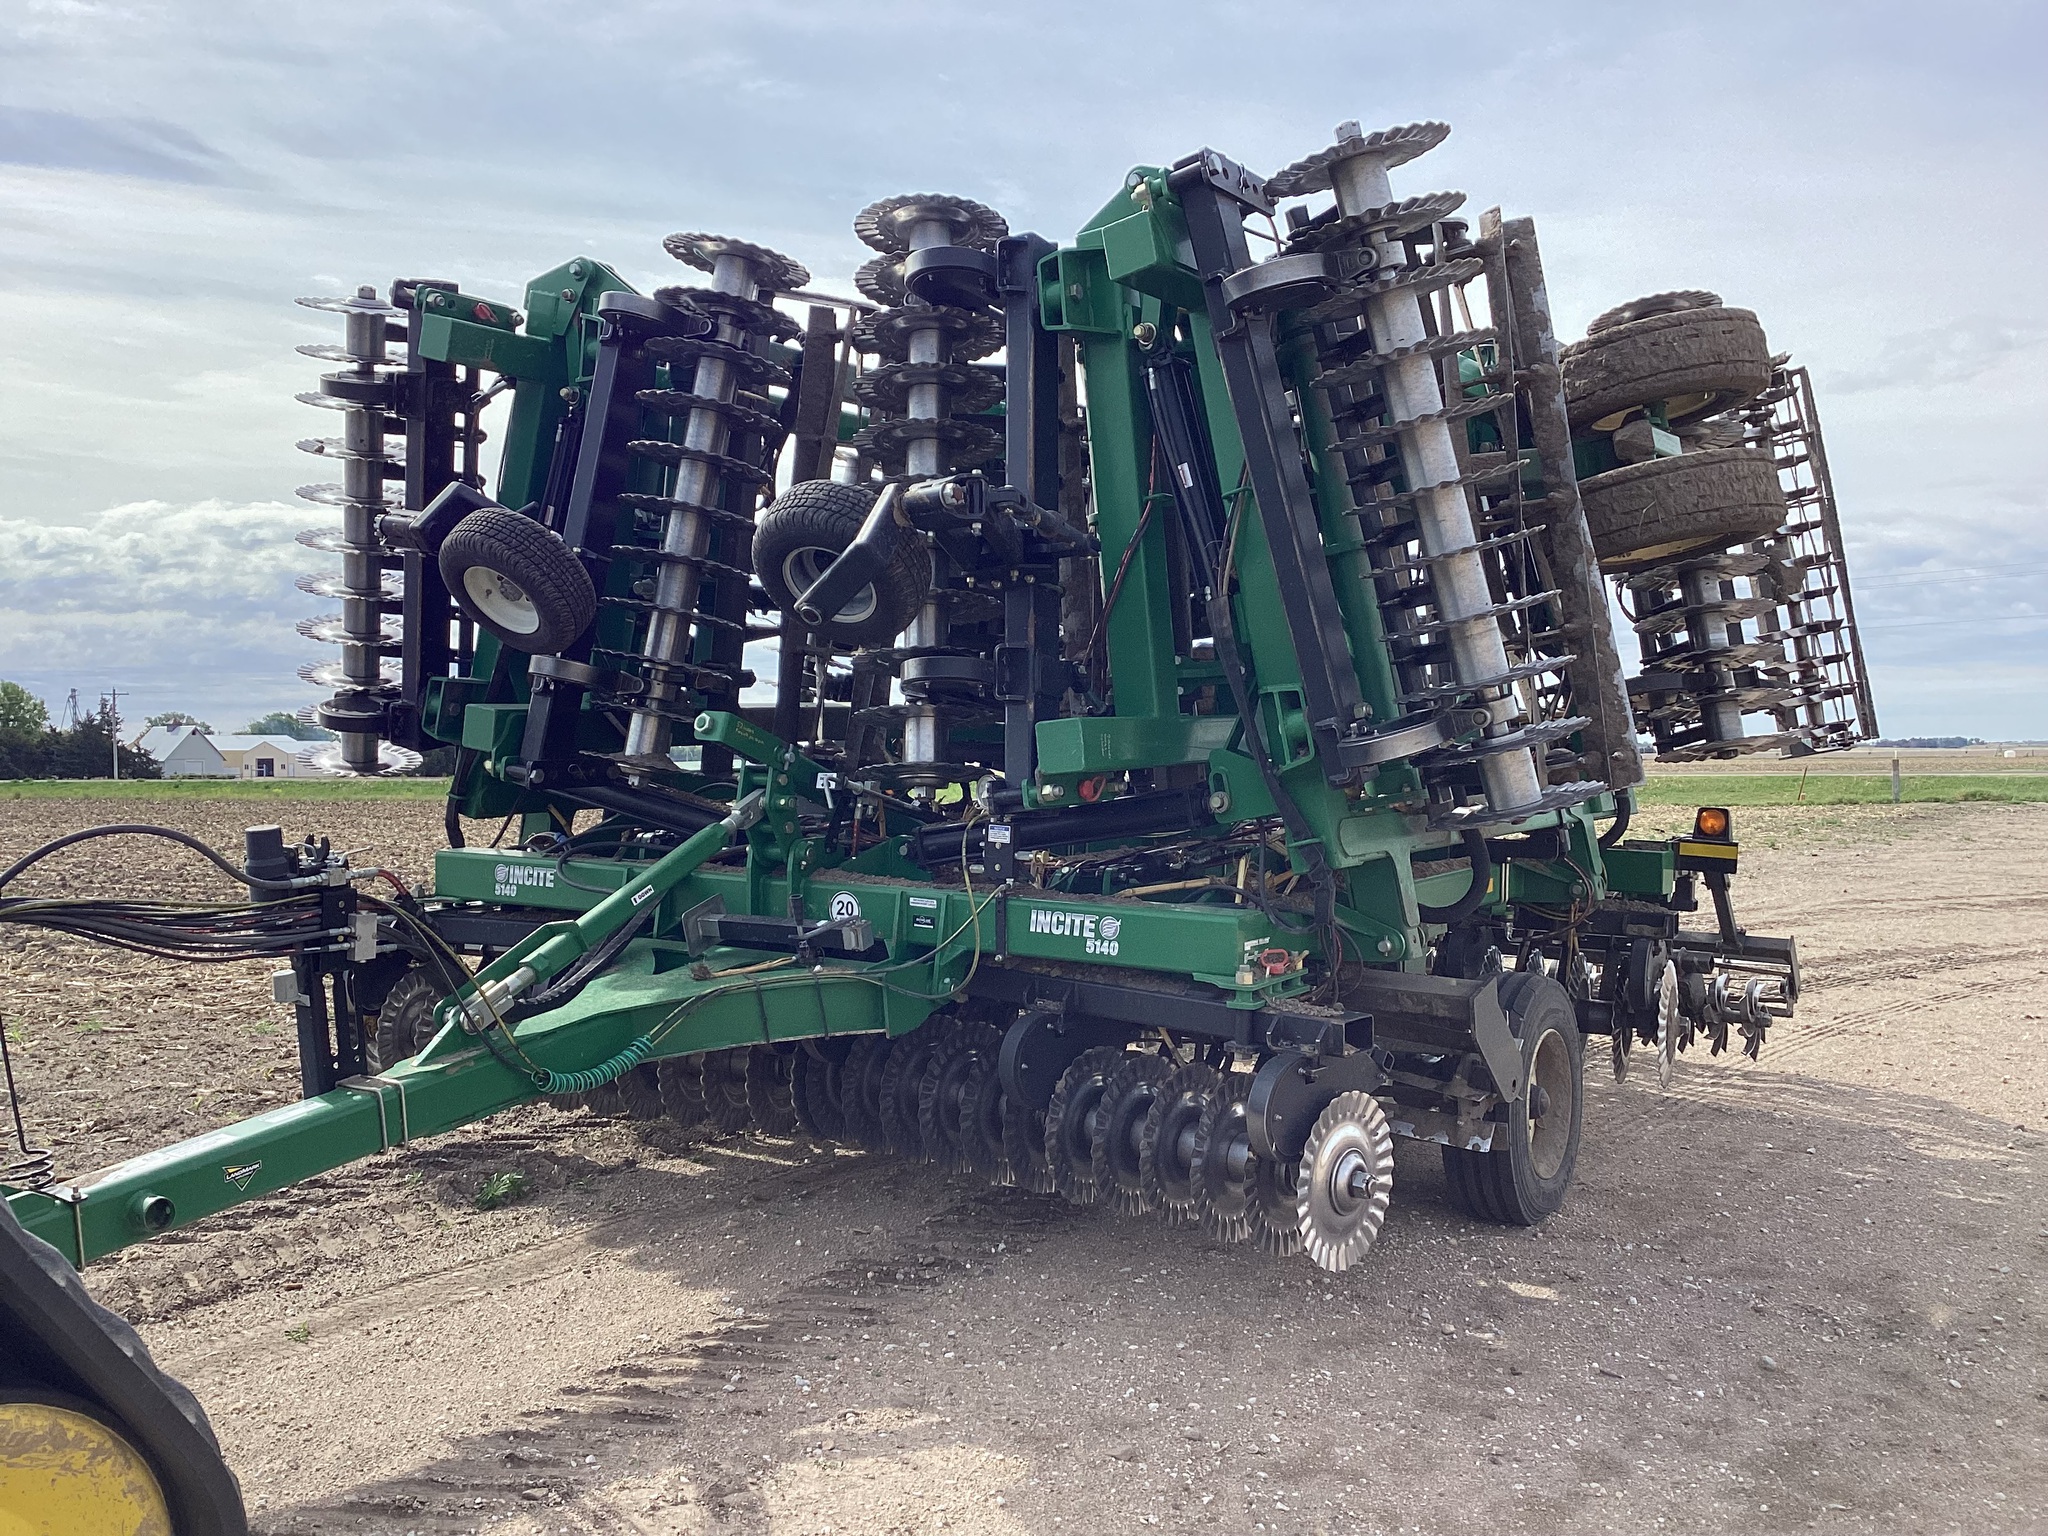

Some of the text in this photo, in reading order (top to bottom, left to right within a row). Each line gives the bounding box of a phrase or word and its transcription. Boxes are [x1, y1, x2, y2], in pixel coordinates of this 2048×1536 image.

[508, 865, 556, 887] INCITE
[494, 883, 517, 897] 5140
[836, 901, 854, 917] 20
[1029, 909, 1096, 938] INCITE
[1085, 938, 1119, 956] 5140
